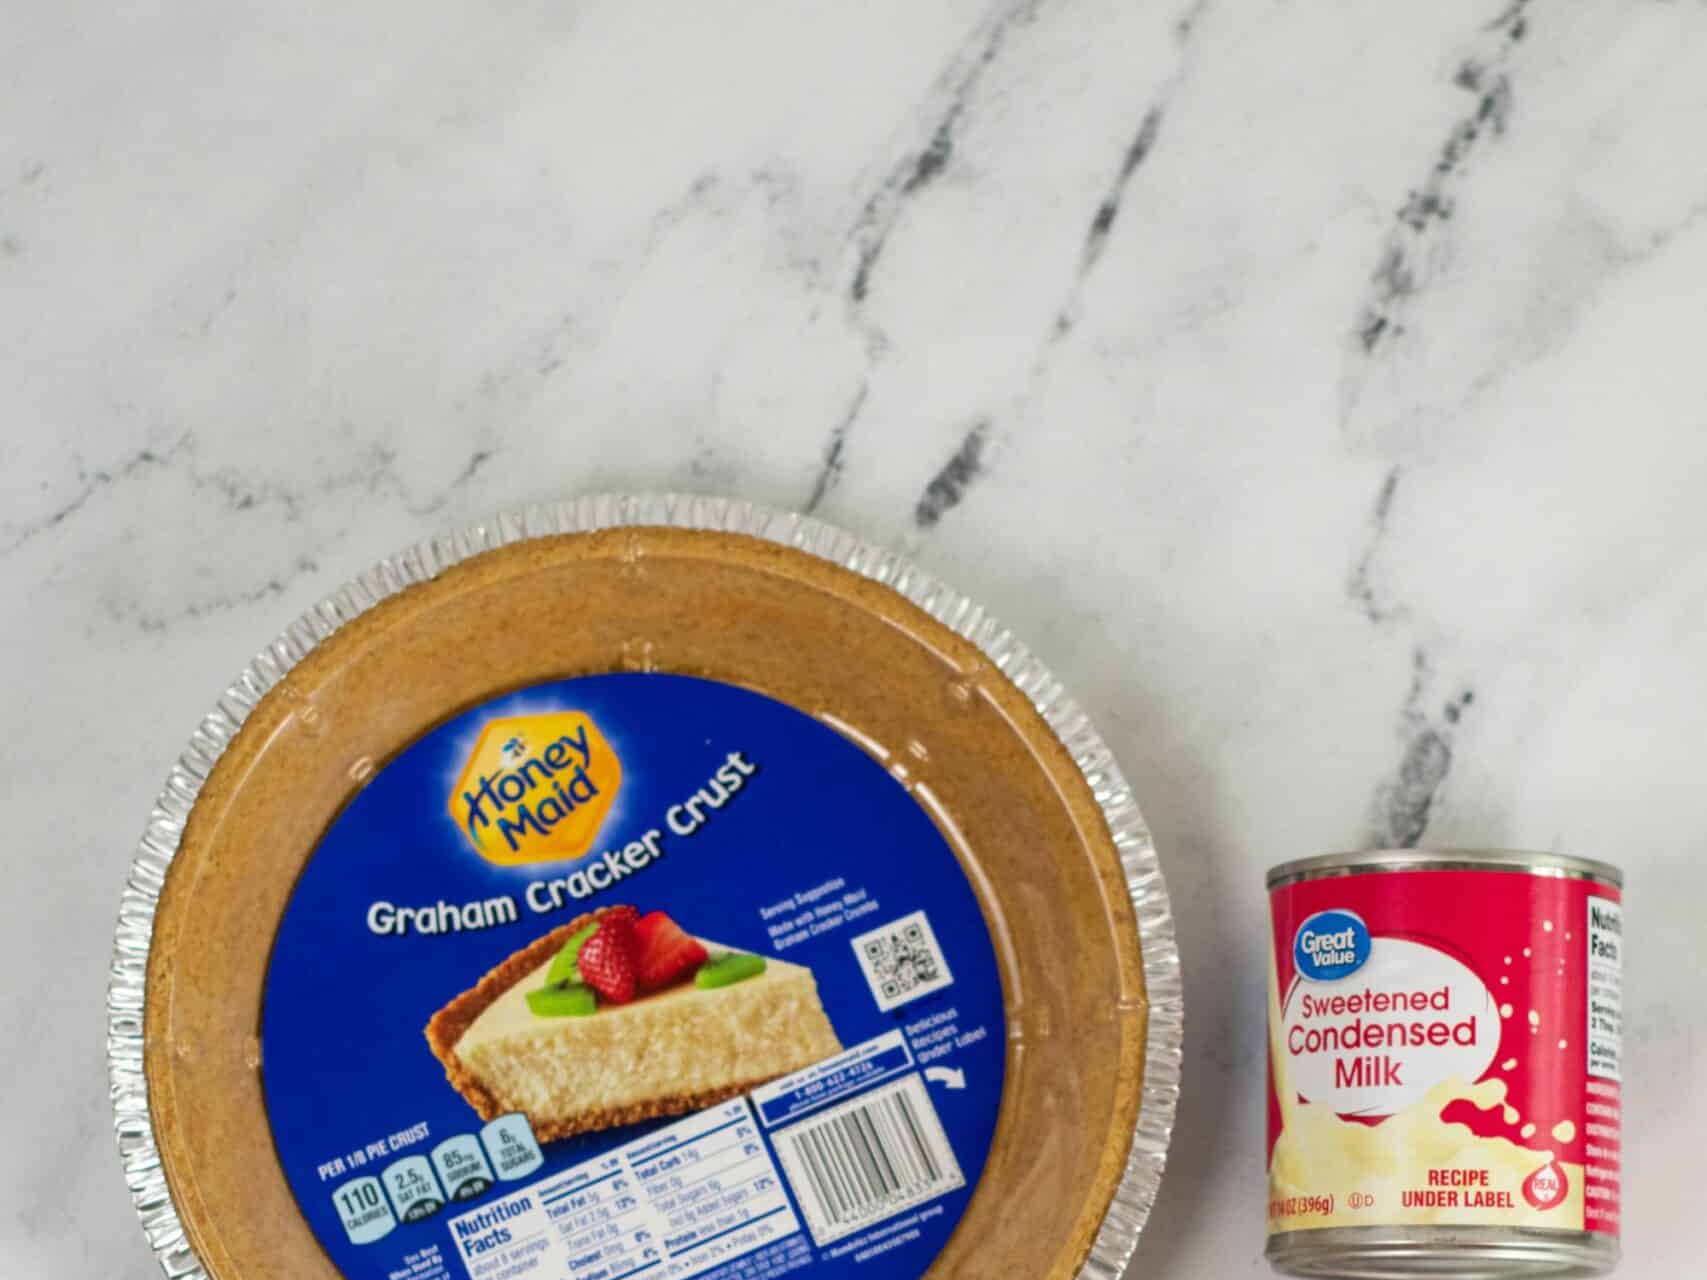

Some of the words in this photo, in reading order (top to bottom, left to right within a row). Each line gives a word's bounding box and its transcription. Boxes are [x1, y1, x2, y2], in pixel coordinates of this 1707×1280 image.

[463, 725, 592, 828] Honey
[498, 765, 599, 851] Maid
[367, 895, 517, 936] Graham
[525, 828, 663, 913] Cracker
[666, 751, 757, 836] Crust
[1301, 927, 1355, 954] Great
[1312, 951, 1355, 968] Value
[1302, 986, 1449, 1019] Sweetened
[954, 1025, 987, 1047] Label
[1288, 1016, 1476, 1056] Condensed
[1335, 1055, 1403, 1089] Milk
[317, 1157, 346, 1180] PER
[366, 1140, 388, 1159] PIE
[388, 1121, 431, 1150] CRUST
[635, 1164, 657, 1180] Total
[659, 1154, 680, 1170] Carb
[1428, 1169, 1489, 1187] RECIPE
[340, 1182, 379, 1215] 110
[546, 1201, 569, 1218] Total
[569, 1194, 585, 1208] Fat
[1402, 1190, 1459, 1208] UNDER
[1463, 1190, 1515, 1208] LABEL
[347, 1206, 388, 1229] CALORIES
[455, 1196, 533, 1239] Nutrition
[462, 1227, 512, 1257] Facts
